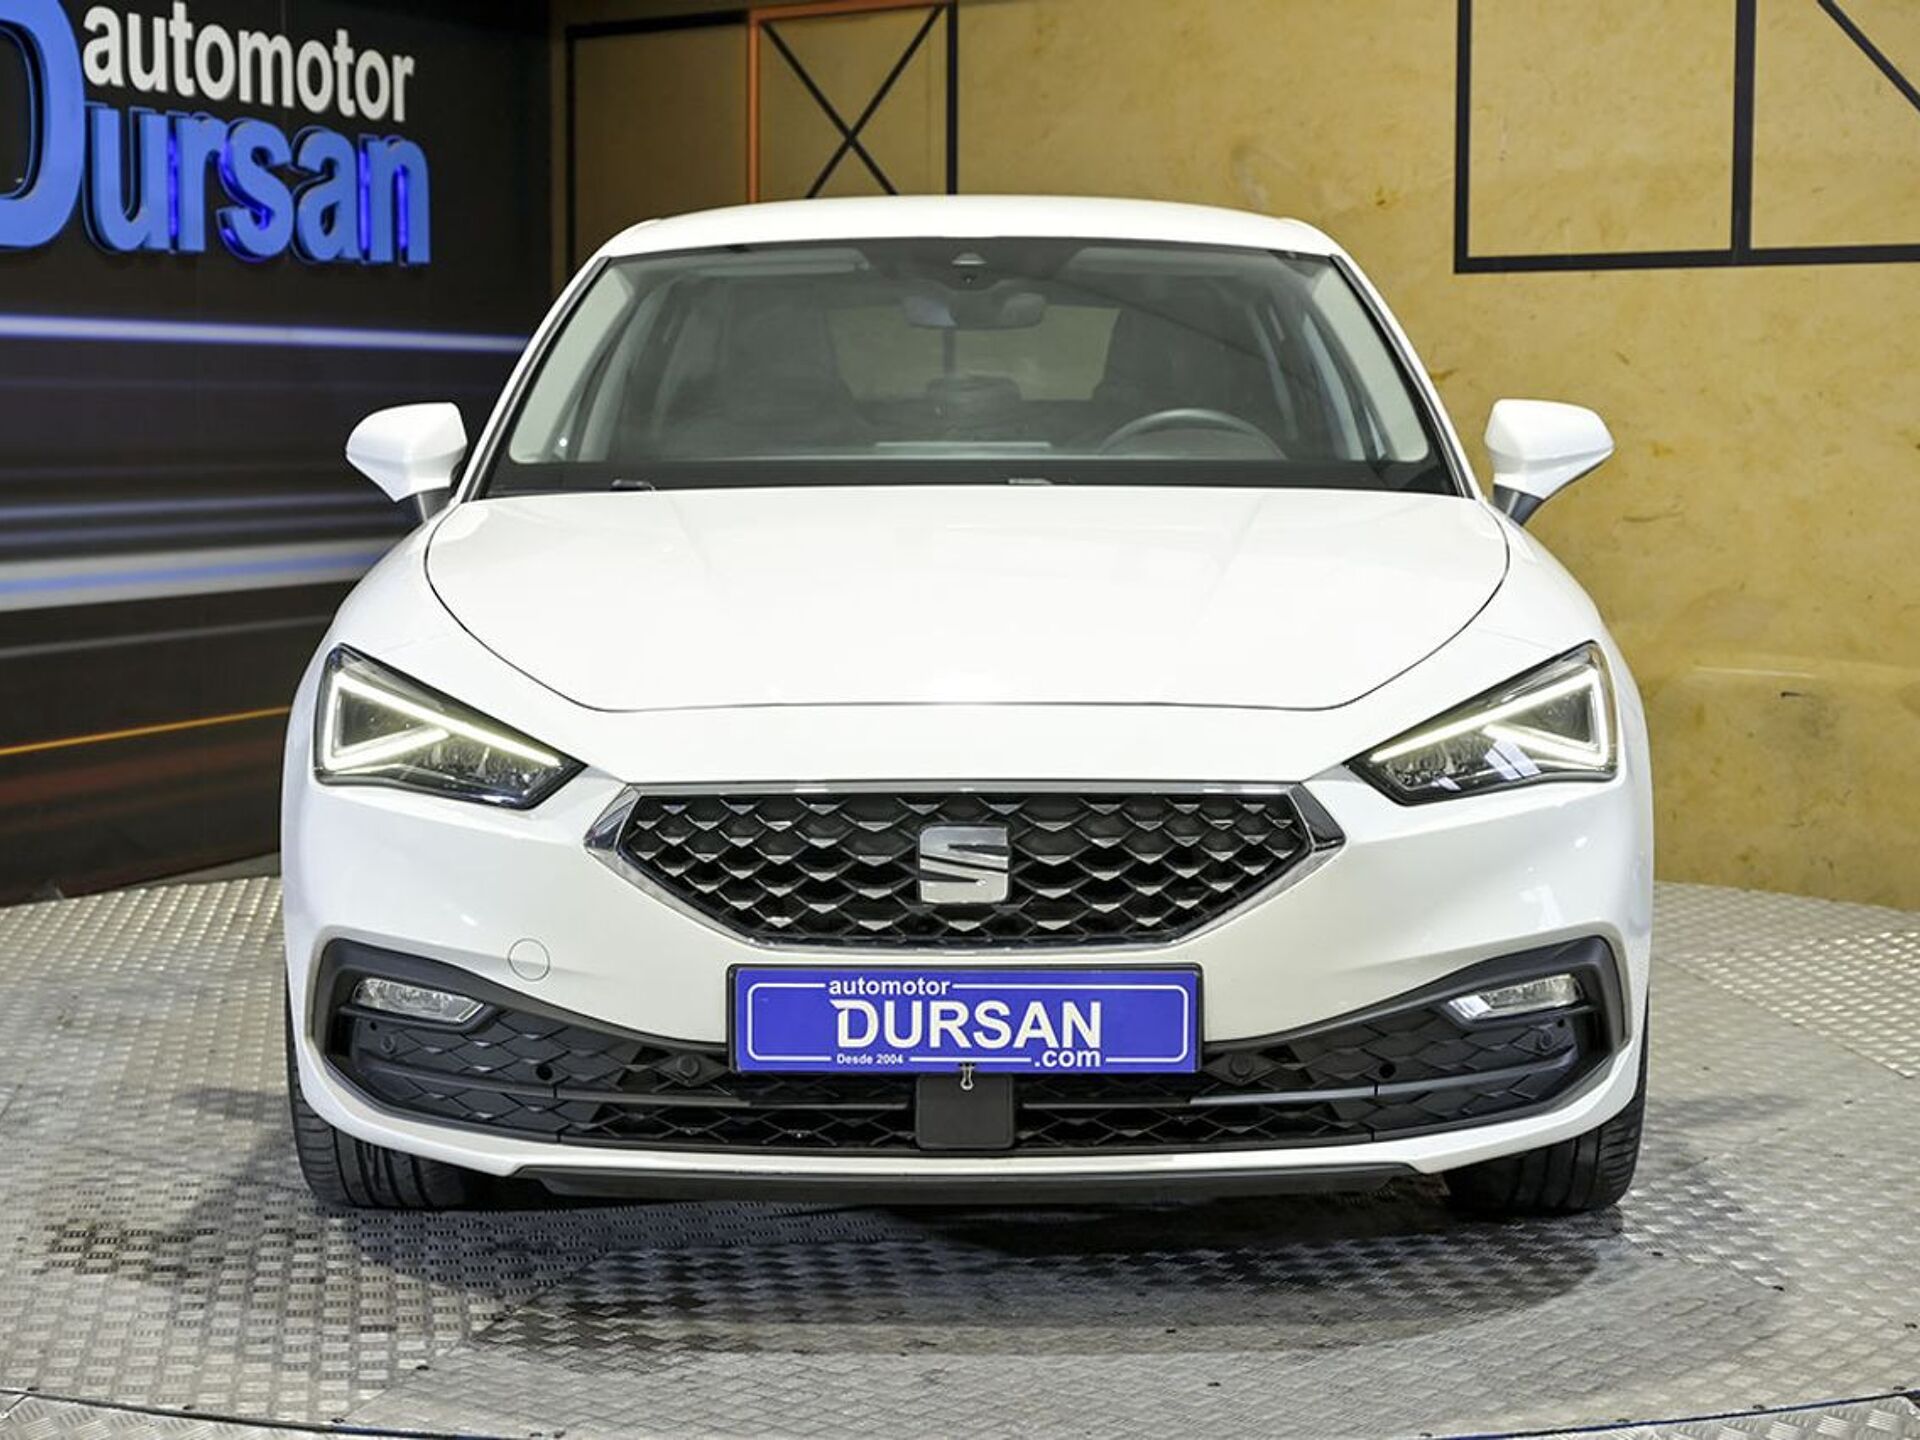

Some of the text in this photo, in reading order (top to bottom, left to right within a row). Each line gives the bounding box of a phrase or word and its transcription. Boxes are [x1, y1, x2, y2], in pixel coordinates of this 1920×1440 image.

[83, 1, 415, 122] automotor
[829, 977, 950, 995] automotor
[829, 999, 1101, 1048] DURSAN
[837, 1053, 904, 1064] Desde 2004
[1034, 1050, 1101, 1068] .com
